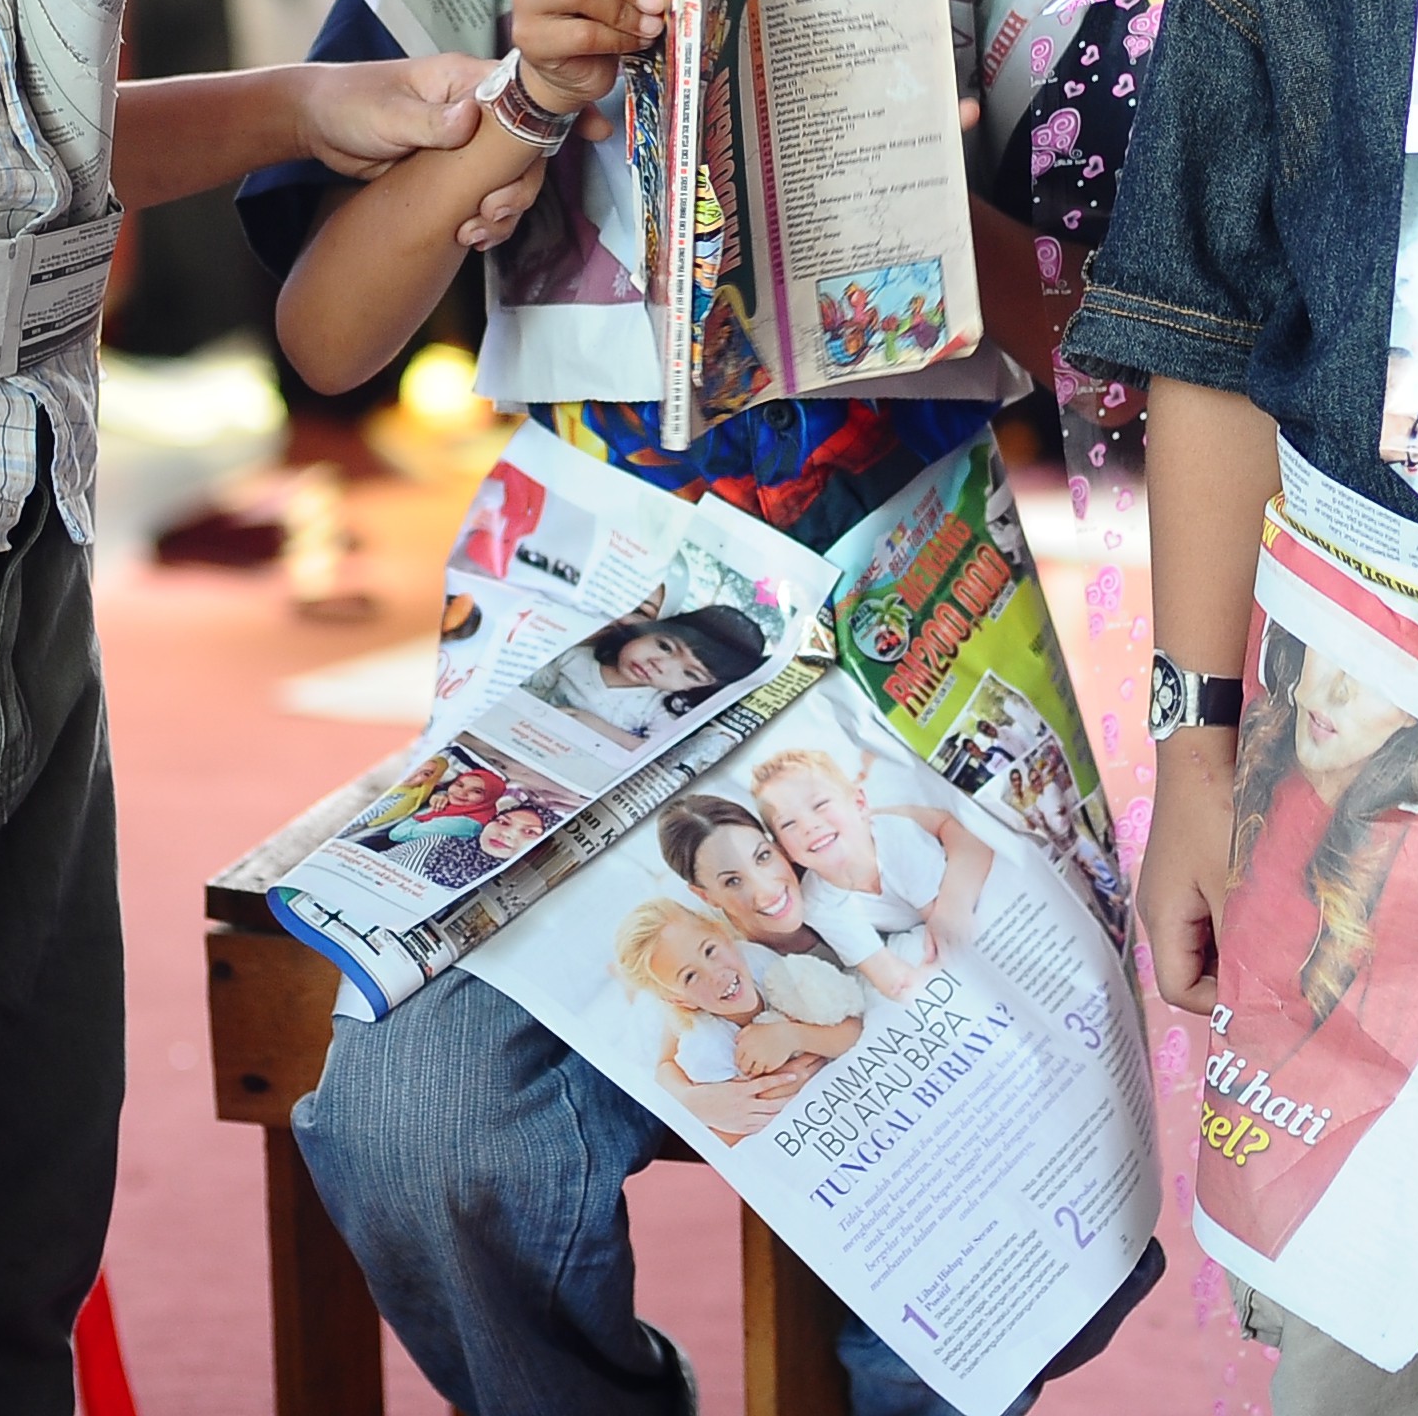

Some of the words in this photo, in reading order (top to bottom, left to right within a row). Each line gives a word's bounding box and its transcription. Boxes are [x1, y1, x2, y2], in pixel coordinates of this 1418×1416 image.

[893, 511, 975, 612] MENANG
[882, 542, 1021, 715] RM200,000
[561, 816, 600, 855] Dari
[1059, 1008, 1106, 1052] 3
[1206, 1001, 1235, 1035] a
[772, 1018, 914, 1159] BAGAIMANA
[898, 966, 964, 1034] JADI
[812, 1114, 862, 1163] IBU
[847, 1061, 916, 1128] ATAU
[902, 1001, 973, 1074] BAPA
[807, 1097, 923, 1216] TUNGGAL
[909, 999, 1020, 1112] BERJAYA?
[1198, 1044, 1249, 1097] di
[1235, 1066, 1332, 1149] hati
[836, 1203, 865, 1233] Tidak
[859, 1175, 893, 1209] mudah
[887, 1145, 923, 1182] menjadi
[930, 1116, 951, 1138] atau
[838, 1198, 895, 1256] menghadapi
[859, 1205, 907, 1254] anak-anak
[862, 1232, 903, 1274] bergelar
[896, 1219, 915, 1239] ibu
[910, 1200, 934, 1224] atau
[928, 1178, 956, 1206] bapa
[865, 1243, 914, 1292] membantu
[907, 1216, 939, 1248] dalam
[1049, 1201, 1097, 1251] 2
[914, 1278, 940, 1304] Lihat
[935, 1253, 965, 1284] Hidup
[923, 1281, 953, 1313] Positif
[894, 1301, 940, 1347] 1
